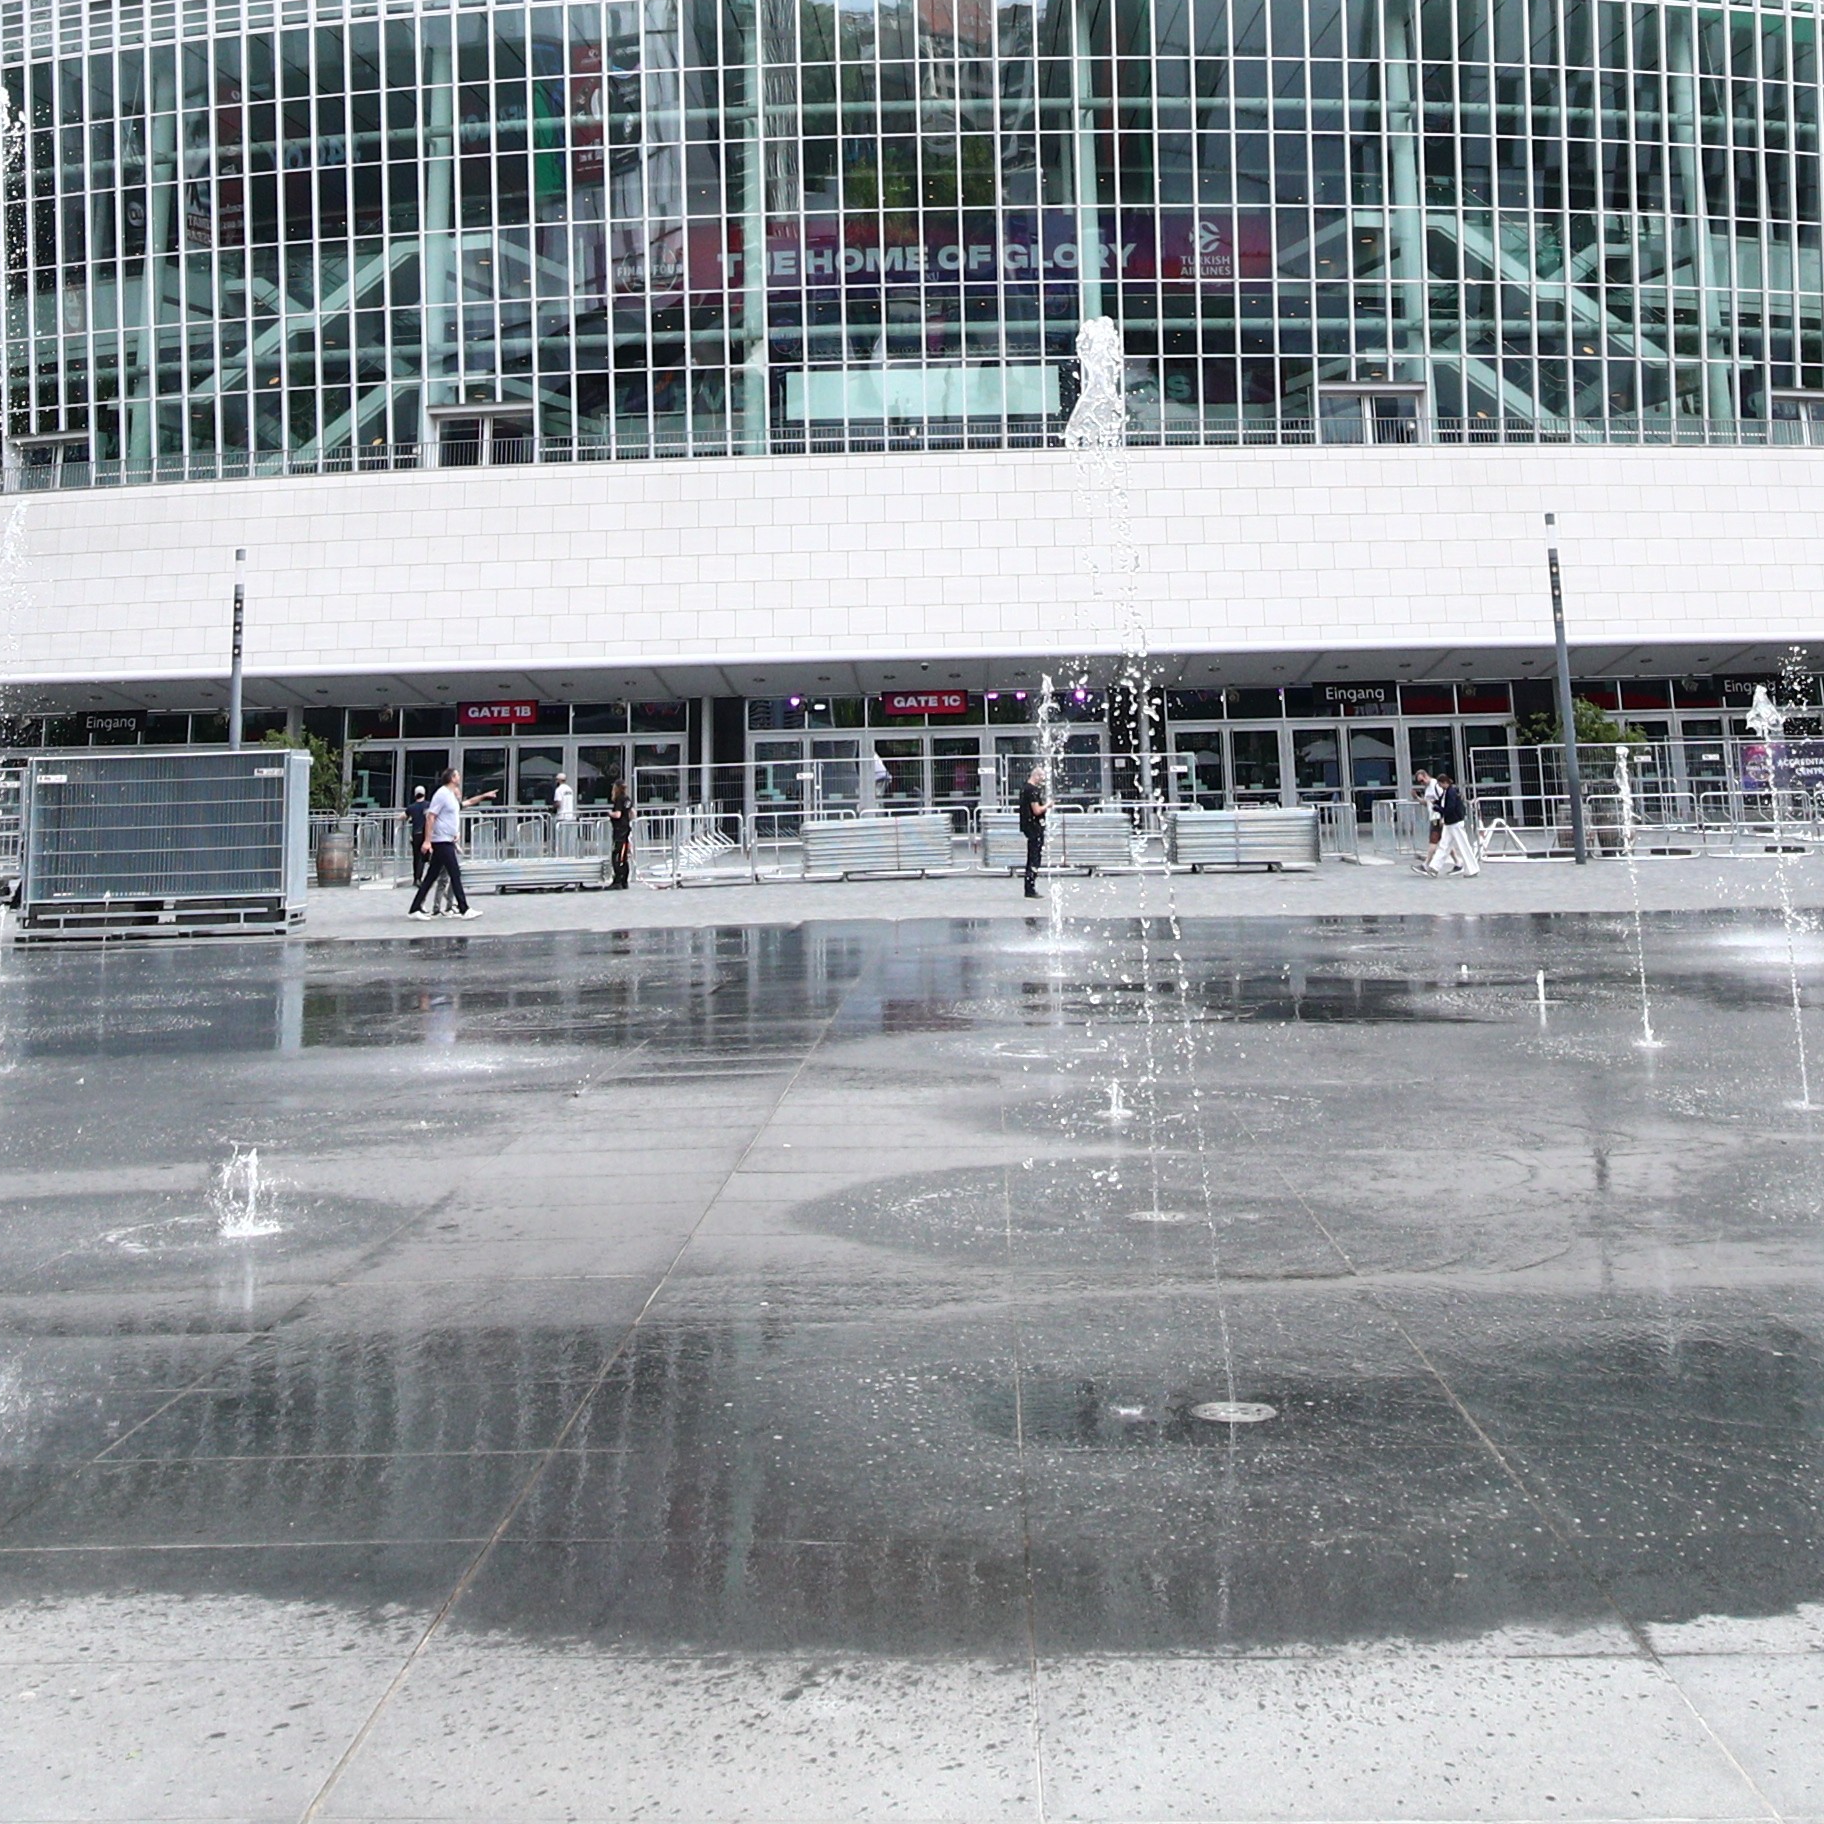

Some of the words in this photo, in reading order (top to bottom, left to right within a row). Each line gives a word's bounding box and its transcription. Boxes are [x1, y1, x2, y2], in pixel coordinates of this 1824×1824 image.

[717, 250, 797, 278] TE
[805, 246, 930, 275] HOME
[937, 244, 992, 270] OF
[617, 263, 647, 277] FINA
[1326, 686, 1385, 702] Eingang
[893, 695, 938, 708] GATE
[942, 695, 961, 707] 1C
[468, 705, 510, 719] GATE
[514, 705, 532, 718] 1B
[86, 716, 136, 731] Eingang
